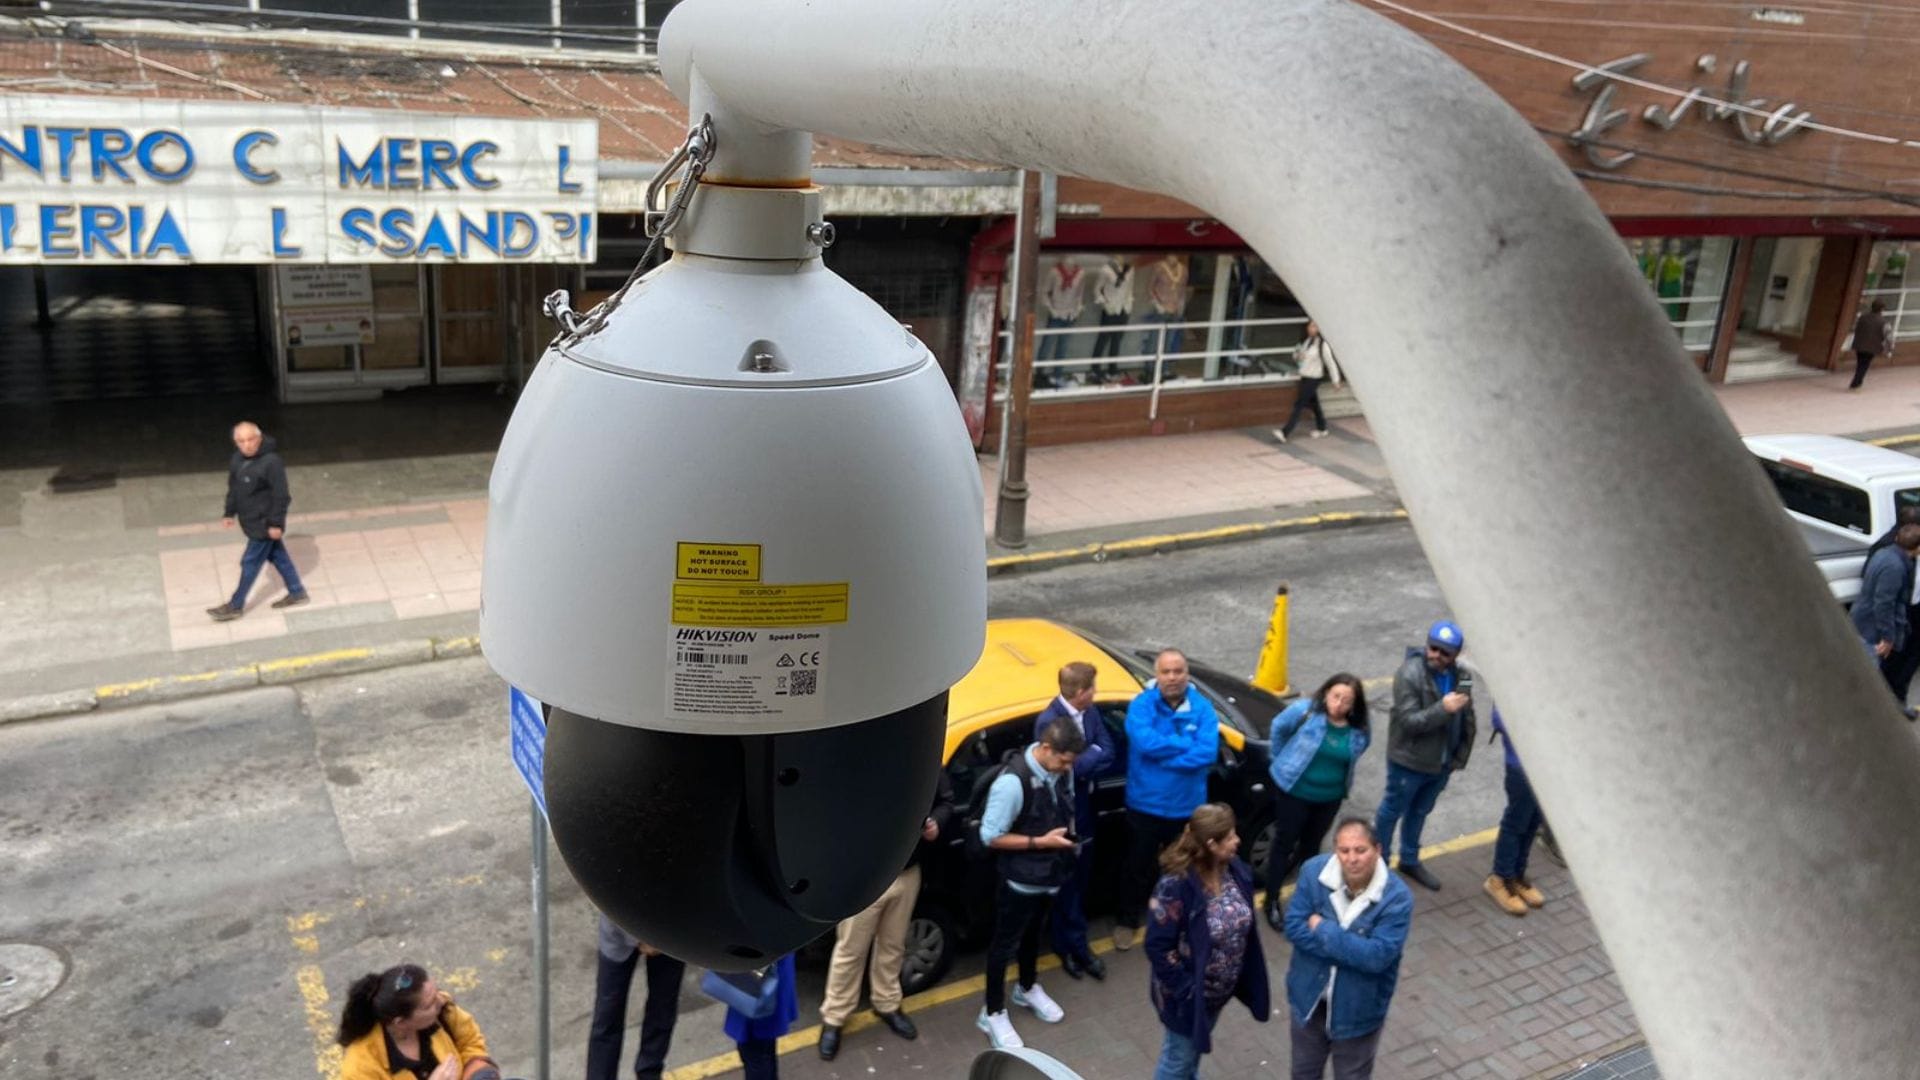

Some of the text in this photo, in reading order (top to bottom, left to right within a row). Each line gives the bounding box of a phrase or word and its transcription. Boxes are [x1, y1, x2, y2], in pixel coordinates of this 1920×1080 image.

[698, 549, 738, 557] WARNING
[720, 568, 750, 576] TOUCH
[676, 628, 820, 643] HIKVISION Speed Dome
